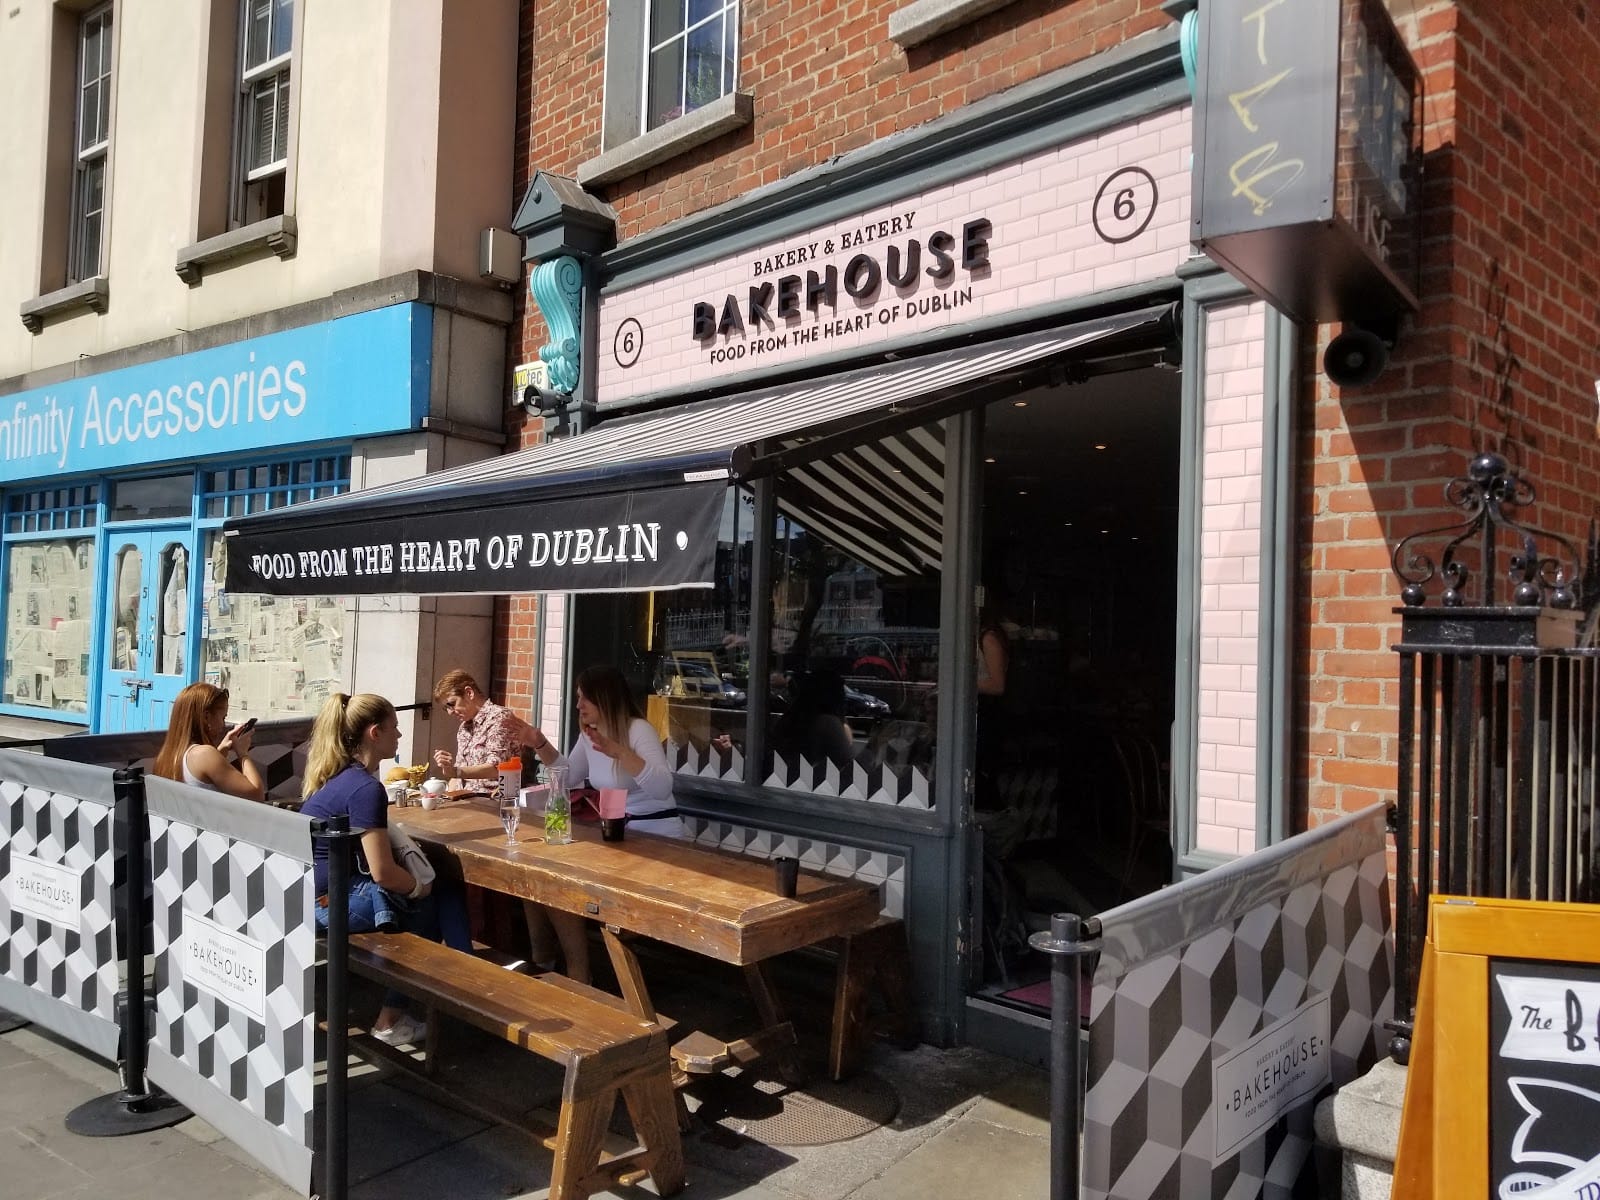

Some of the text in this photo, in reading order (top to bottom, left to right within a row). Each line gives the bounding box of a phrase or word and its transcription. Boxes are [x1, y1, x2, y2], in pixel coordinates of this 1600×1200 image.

[1113, 188, 1136, 221] 6
[753, 211, 916, 277] BAKERY & EATERY
[692, 217, 993, 343] BAKEHOUSE
[623, 332, 634, 354] 6
[709, 286, 973, 365] FOOD FROM THE HEART OF DUBLIN
[79, 351, 307, 449] Accessories
[251, 553, 296, 581] FOOD
[299, 548, 348, 579] FROM
[353, 543, 394, 576] THE
[399, 538, 481, 573] HEART
[486, 534, 523, 571] OF
[529, 522, 661, 568] DUBLIN
[19, 876, 71, 905] BAKEHOUSE
[193, 942, 253, 986] BAKEHOUSE
[1521, 1004, 1552, 1030] The
[1233, 1035, 1319, 1113] BAKEHOUSE
